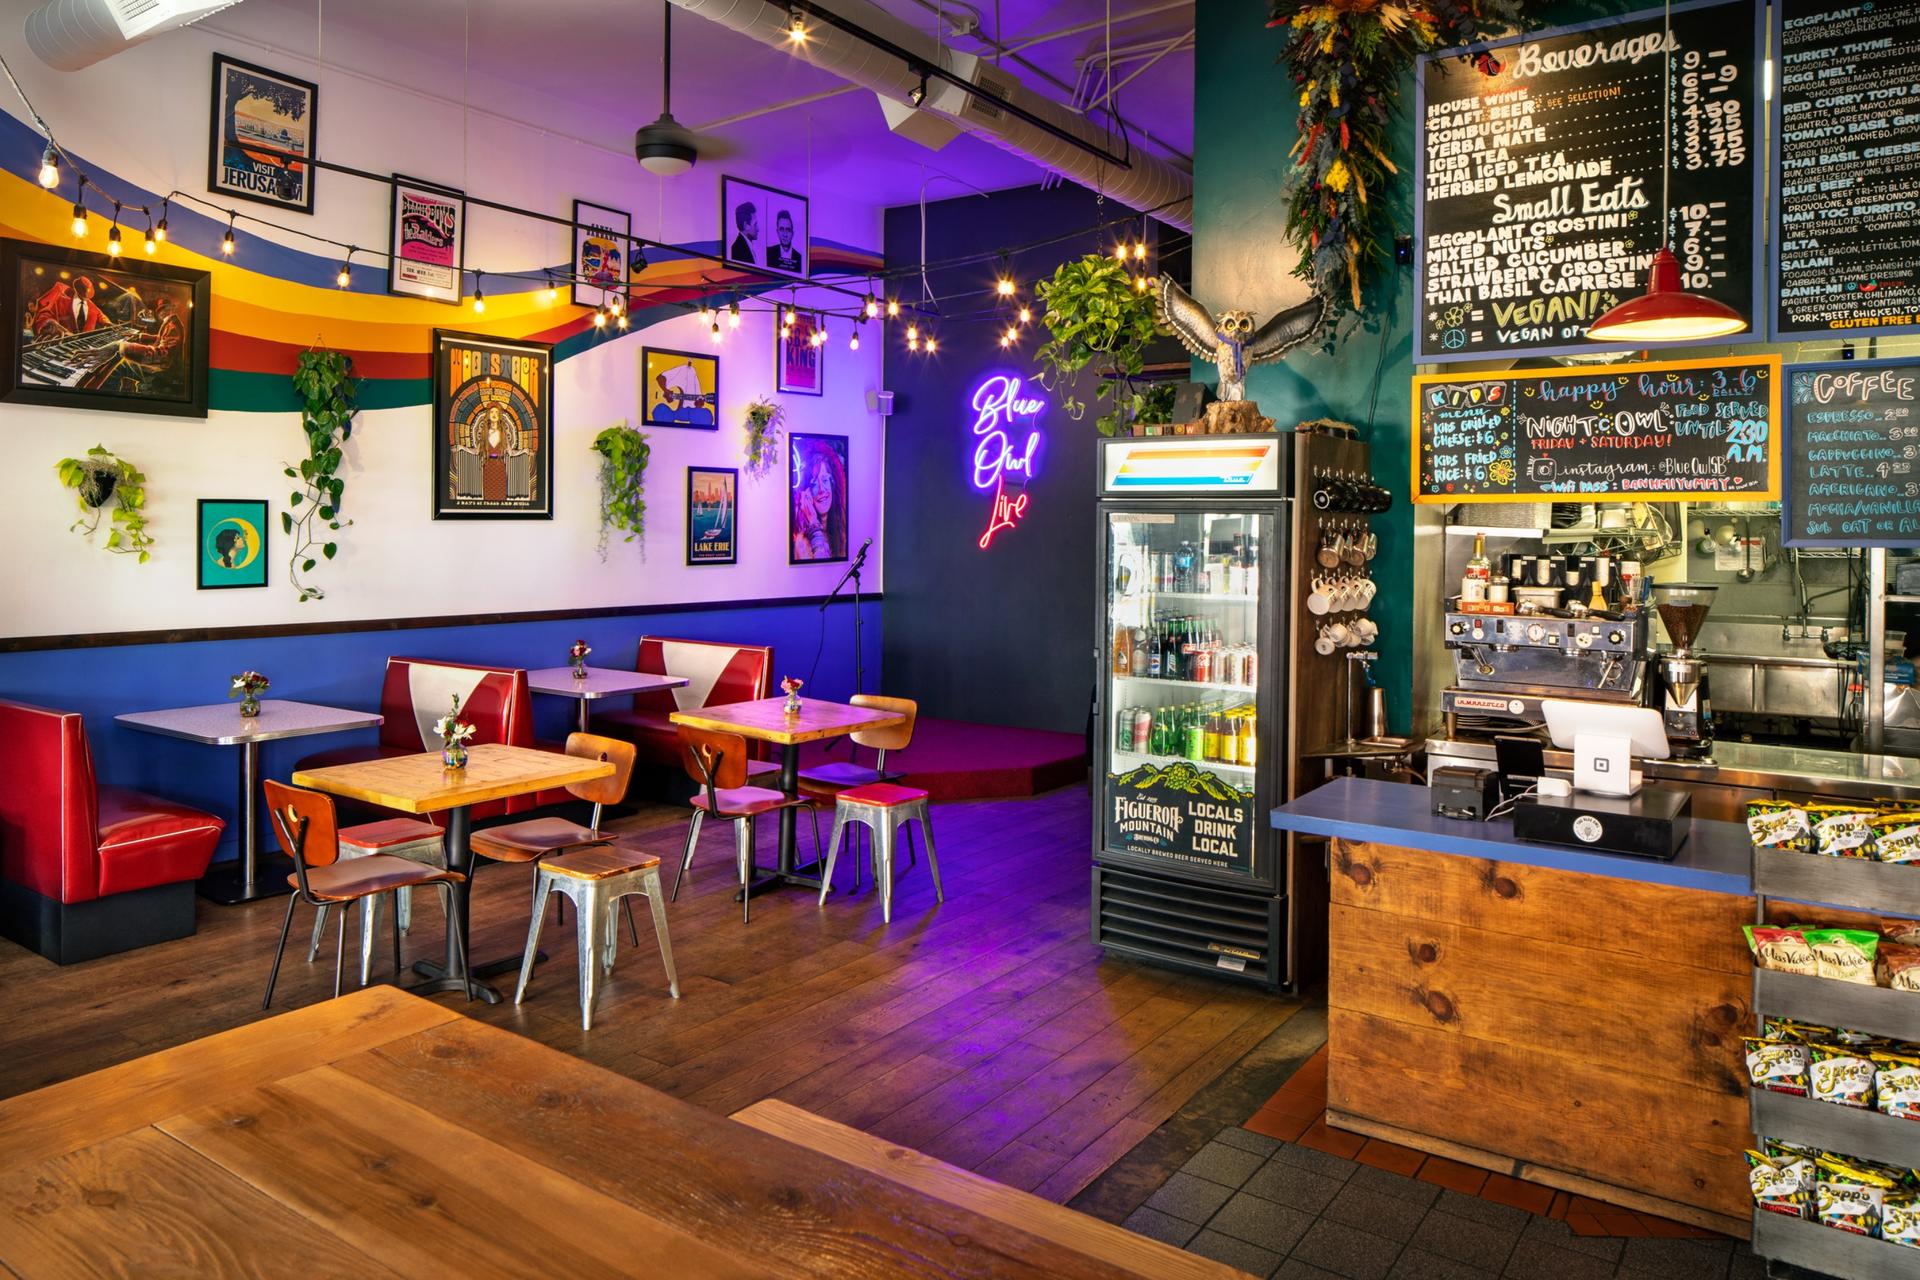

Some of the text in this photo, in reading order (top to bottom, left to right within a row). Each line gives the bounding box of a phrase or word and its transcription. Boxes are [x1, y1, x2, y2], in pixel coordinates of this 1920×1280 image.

[1783, 7, 1861, 30] EGGPLANT
[1512, 29, 1682, 80] Beverages
[1783, 47, 1839, 65] TURKEY
[1842, 38, 1893, 54] THYME
[1783, 65, 1856, 85] EGG MELT
[1427, 88, 1529, 118] HOUSE WINE
[1429, 109, 1484, 131] CRAFT
[1490, 100, 1536, 120] BEER
[1568, 86, 1622, 103] SELECTION!
[1783, 86, 1908, 115] RED CURRY TOFU
[1427, 115, 1533, 146] KOMBUCHA
[1782, 125, 1846, 143] TOMATO
[1848, 118, 1890, 133] BASIL
[1427, 137, 1487, 160] YERBA
[1493, 127, 1546, 149] MATE
[252, 161, 276, 175] VISIT
[1427, 167, 1472, 187] THAI
[1476, 160, 1519, 179] ICED
[1524, 152, 1566, 172] TEA
[1429, 154, 1470, 173] ICED
[1472, 148, 1510, 165] TEA
[1781, 157, 1816, 170] THAI
[1819, 150, 1861, 165] BASIL
[1427, 177, 1498, 201] HERBED
[1503, 160, 1612, 189] LEMONADE
[1782, 178, 1854, 197] BLUE BEEF
[1492, 175, 1651, 224] Small Eats
[1831, 189, 1854, 199] BEEF
[1854, 190, 1919, 205] GREEN ONIONS
[1782, 211, 1815, 224] NAM
[1818, 207, 1849, 219] TOC
[1852, 201, 1917, 216] BURRITO
[1428, 213, 1628, 249] EGGPLANT CROSTINI
[1426, 236, 1546, 264] MIXED NUTS
[1782, 239, 1820, 251] BLTA
[1428, 241, 1628, 278] SALTED CUCUMBER
[1781, 257, 1834, 271] SALAMI
[1425, 272, 1636, 306] THAI BASIL CAPRESE
[1427, 264, 1553, 292] STRAWBERRY
[1839, 272, 1869, 283] THYME
[1781, 284, 1843, 298] BANH-MI
[1829, 292, 1864, 303] OYSTER
[1491, 290, 1600, 329] VEGAN!
[1796, 302, 1859, 314] GREEN ONIONS
[1829, 315, 1912, 329] GLUTEN FREE
[1496, 326, 1554, 344] VEGAN
[786, 350, 816, 369] KING
[1537, 380, 1625, 402] happy
[1813, 370, 1916, 404] COFFEE
[972, 375, 1046, 435] Blue
[1438, 408, 1492, 419] menu
[1675, 400, 1769, 420] FOOD SERVED
[1807, 408, 1875, 424] ESPRESSO
[1531, 437, 1575, 450] FRIDAY
[1590, 434, 1673, 449] SATURDAY!
[1726, 419, 1769, 445] 230
[1807, 429, 1880, 443] MACCHIATO
[974, 430, 1041, 489] Owl
[1808, 447, 1894, 461] CAPPUCCINO
[1809, 463, 1866, 479] LATTE
[1809, 482, 1898, 497] AMERICANO
[979, 474, 1029, 549] Live
[1841, 518, 1872, 534] OAT
[694, 541, 730, 552] LAKE ERIE
[1114, 795, 1184, 834] FIGUEROA
[1188, 800, 1244, 823] LOCALS
[1119, 820, 1174, 842] MOUNTAIN
[1194, 819, 1237, 840] DRINK
[1127, 844, 1229, 868] LOCALLY BREWED BEER SERVED HERE
[1191, 835, 1239, 858] LOCAL
